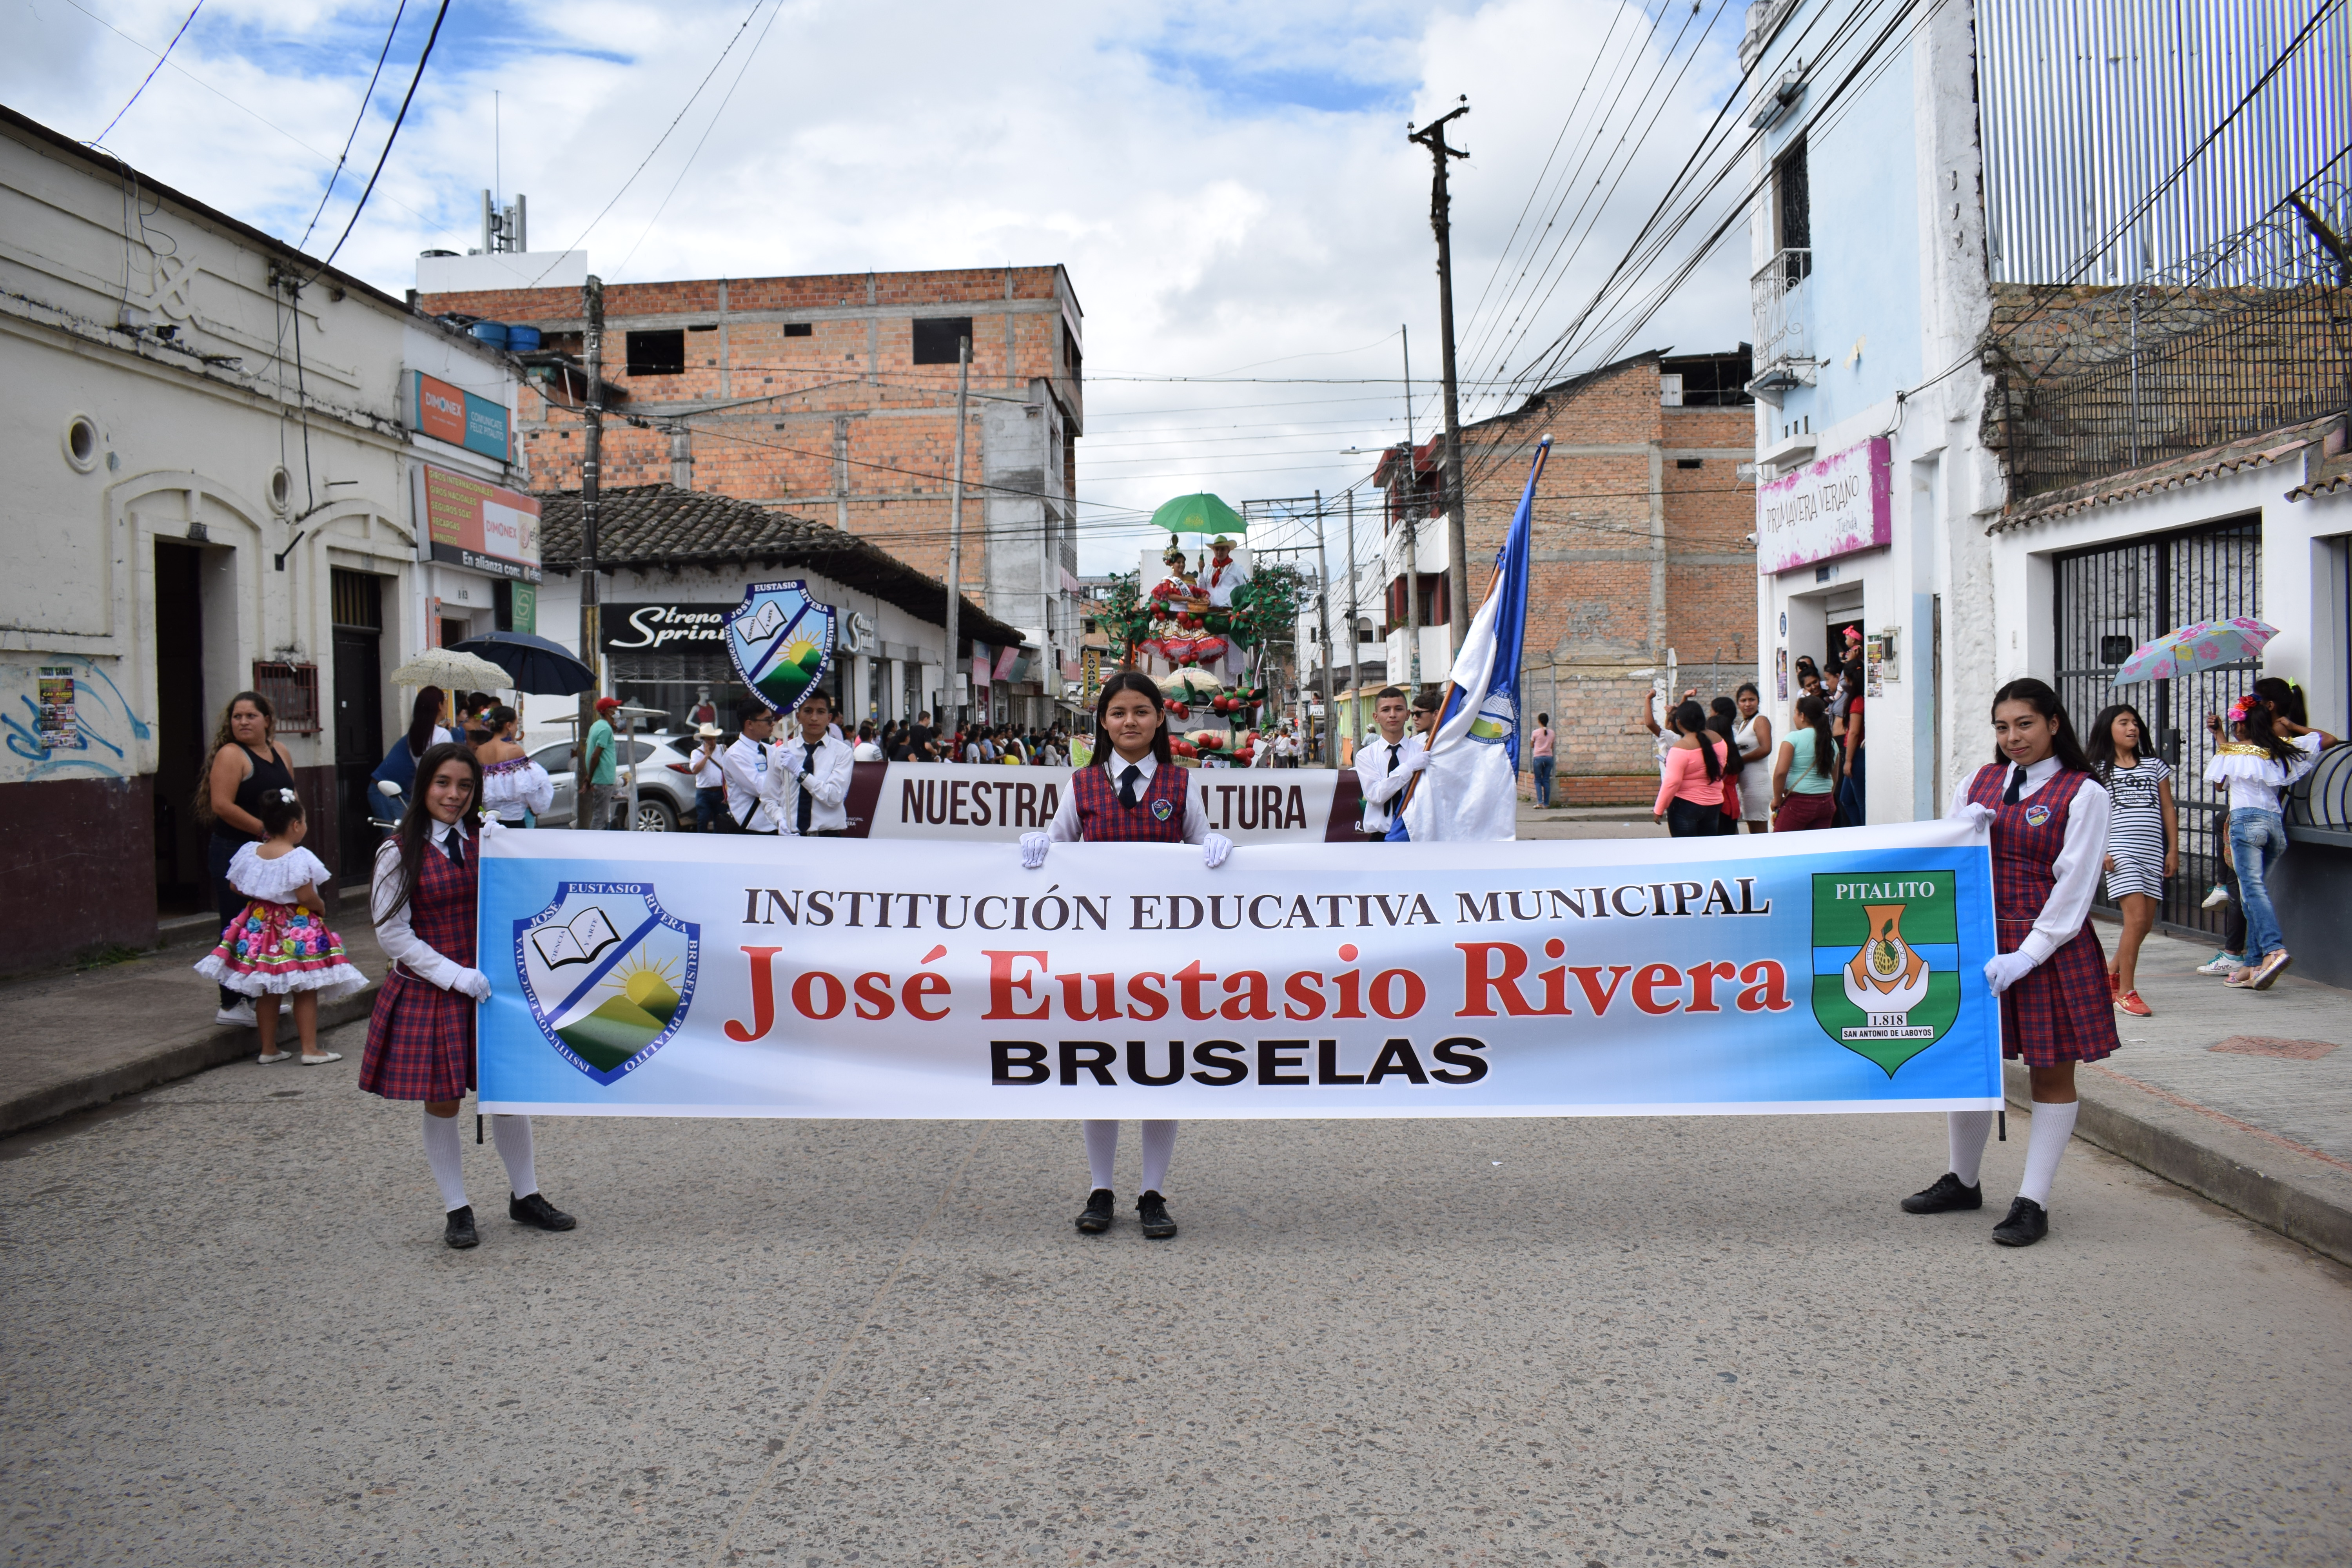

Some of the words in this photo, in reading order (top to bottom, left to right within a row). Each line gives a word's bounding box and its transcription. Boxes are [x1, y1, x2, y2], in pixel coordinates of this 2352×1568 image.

[425, 392, 462, 417] DIMONEX
[470, 422, 483, 434] FELIZ
[483, 425, 503, 441] PITALITO
[429, 470, 446, 482] GIROS
[447, 475, 493, 497] INTERNACIONALES
[430, 485, 447, 497] GIROS
[431, 501, 457, 515] SEGUROS
[458, 508, 472, 519] SOAT
[1767, 492, 1818, 533] PRIMAVERA
[1819, 475, 1859, 512] VERANO
[432, 516, 460, 531] RECARGAS
[434, 531, 457, 545] MINUTOS
[486, 520, 517, 539] DIMONEX
[1837, 511, 1858, 534] Tienda
[463, 551, 474, 566] En
[475, 555, 503, 574] alianza
[504, 564, 521, 577] con:
[731, 598, 752, 619] JOSE
[754, 581, 797, 592] EUSTASIO
[799, 588, 829, 612] RIVERA
[609, 606, 724, 647] Streno
[747, 619, 755, 639] CIENCIA
[820, 616, 834, 668] BRUSELAS
[725, 624, 742, 670] EDUCATIVA
[738, 669, 778, 711] INSTITUCION
[793, 671, 822, 709] PITALITO
[1494, 688, 1508, 698] JOSE
[1509, 693, 1519, 719] EUSTASIO
[67, 706, 74, 715] 23
[1469, 734, 1488, 743] PITALITO
[902, 779, 1060, 828] NUESTRA
[1201, 785, 1307, 830] LTURA
[742, 884, 1111, 931] INSTITUCIÓN
[1129, 893, 1441, 930] EDUCATIVA
[1455, 878, 1770, 923] MUNICIPAL
[1835, 881, 1935, 900] PITALITO
[530, 901, 561, 928] JOSE
[568, 883, 641, 894] EUSTASIO
[645, 893, 687, 933] RIVERA
[550, 930, 566, 962] CIENCIA
[587, 918, 598, 939] ARTE
[515, 937, 539, 1010] EDUCATIVA
[679, 939, 698, 1007] BRUSELA
[2210, 962, 2232, 971] love
[724, 944, 951, 1042] José
[981, 944, 1426, 1021] Eustasio
[1455, 938, 1791, 1017] Rivera
[1872, 1014, 1903, 1025] 1.818
[535, 1011, 590, 1073] INSTITUCION
[624, 1016, 682, 1072] PITALITO
[990, 1037, 1488, 1086] BRUSELAS
